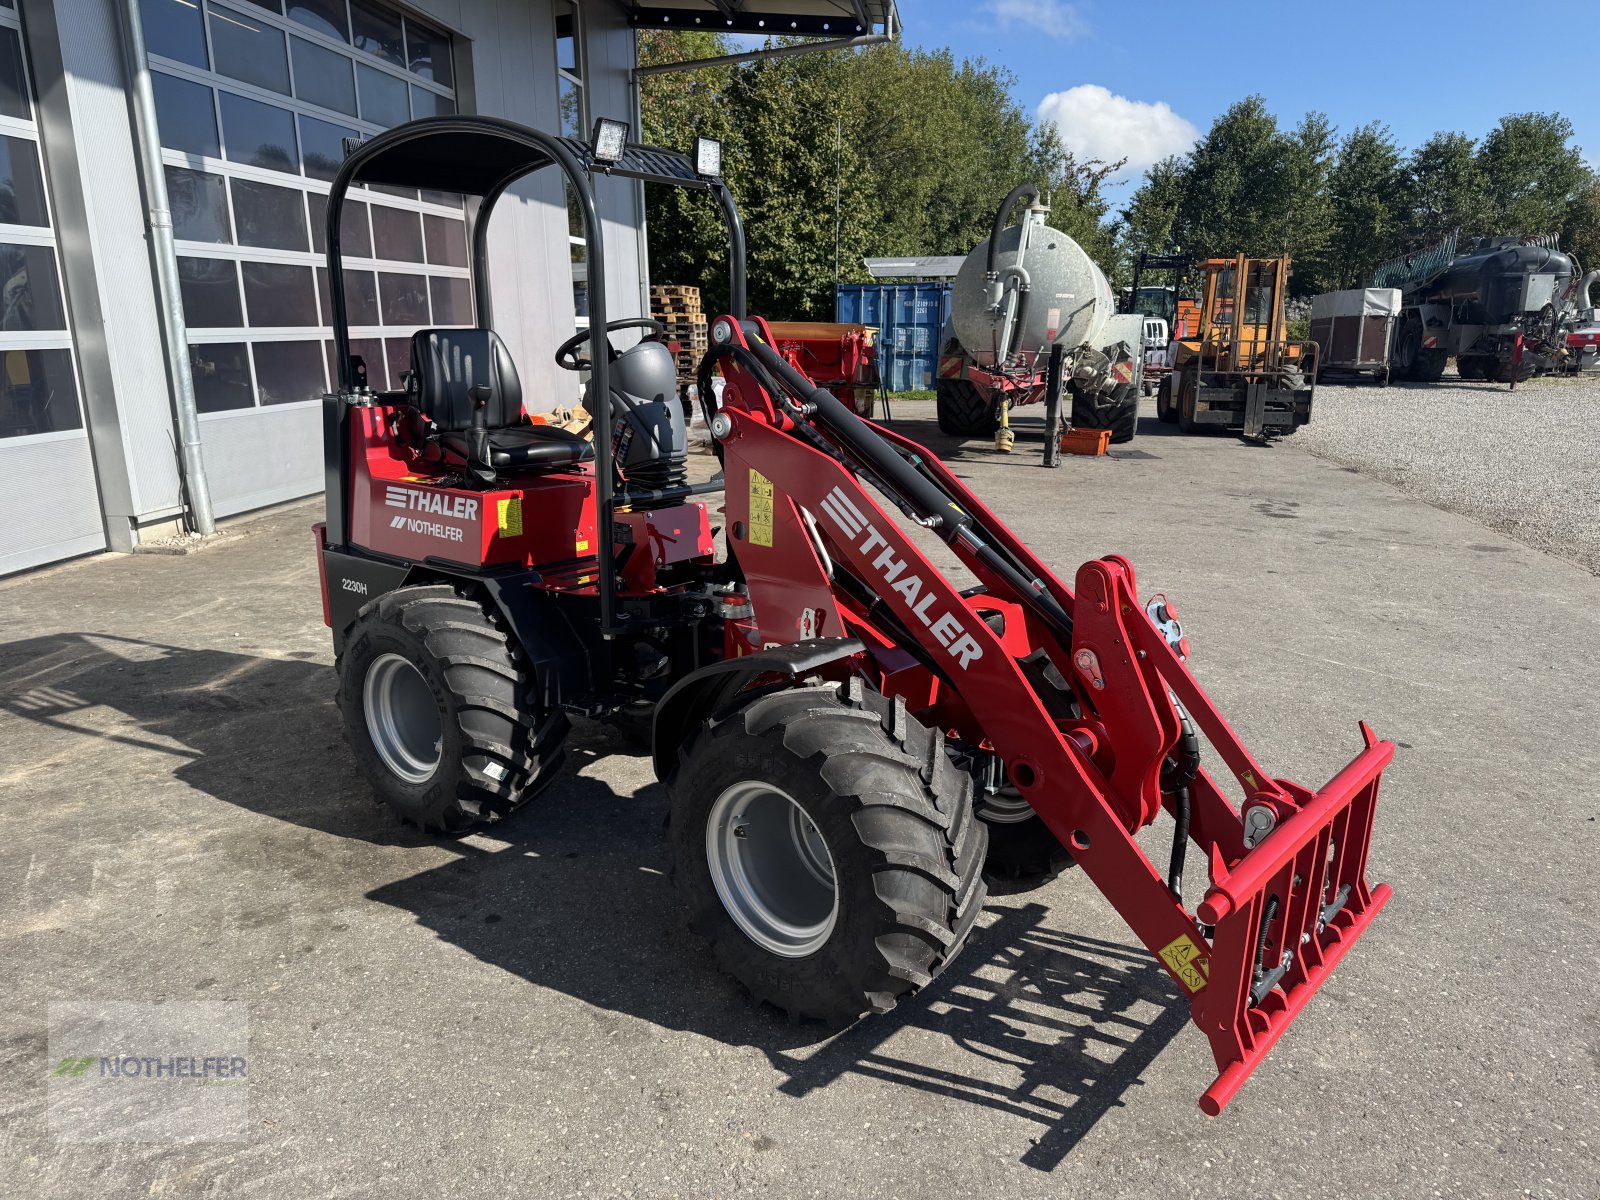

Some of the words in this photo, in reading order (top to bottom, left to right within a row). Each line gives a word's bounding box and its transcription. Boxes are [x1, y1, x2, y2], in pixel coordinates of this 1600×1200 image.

[407, 488, 478, 520] THALER
[407, 519, 463, 542] NOTHELFER
[342, 578, 368, 595] 2230H
[858, 524, 983, 670] THALER
